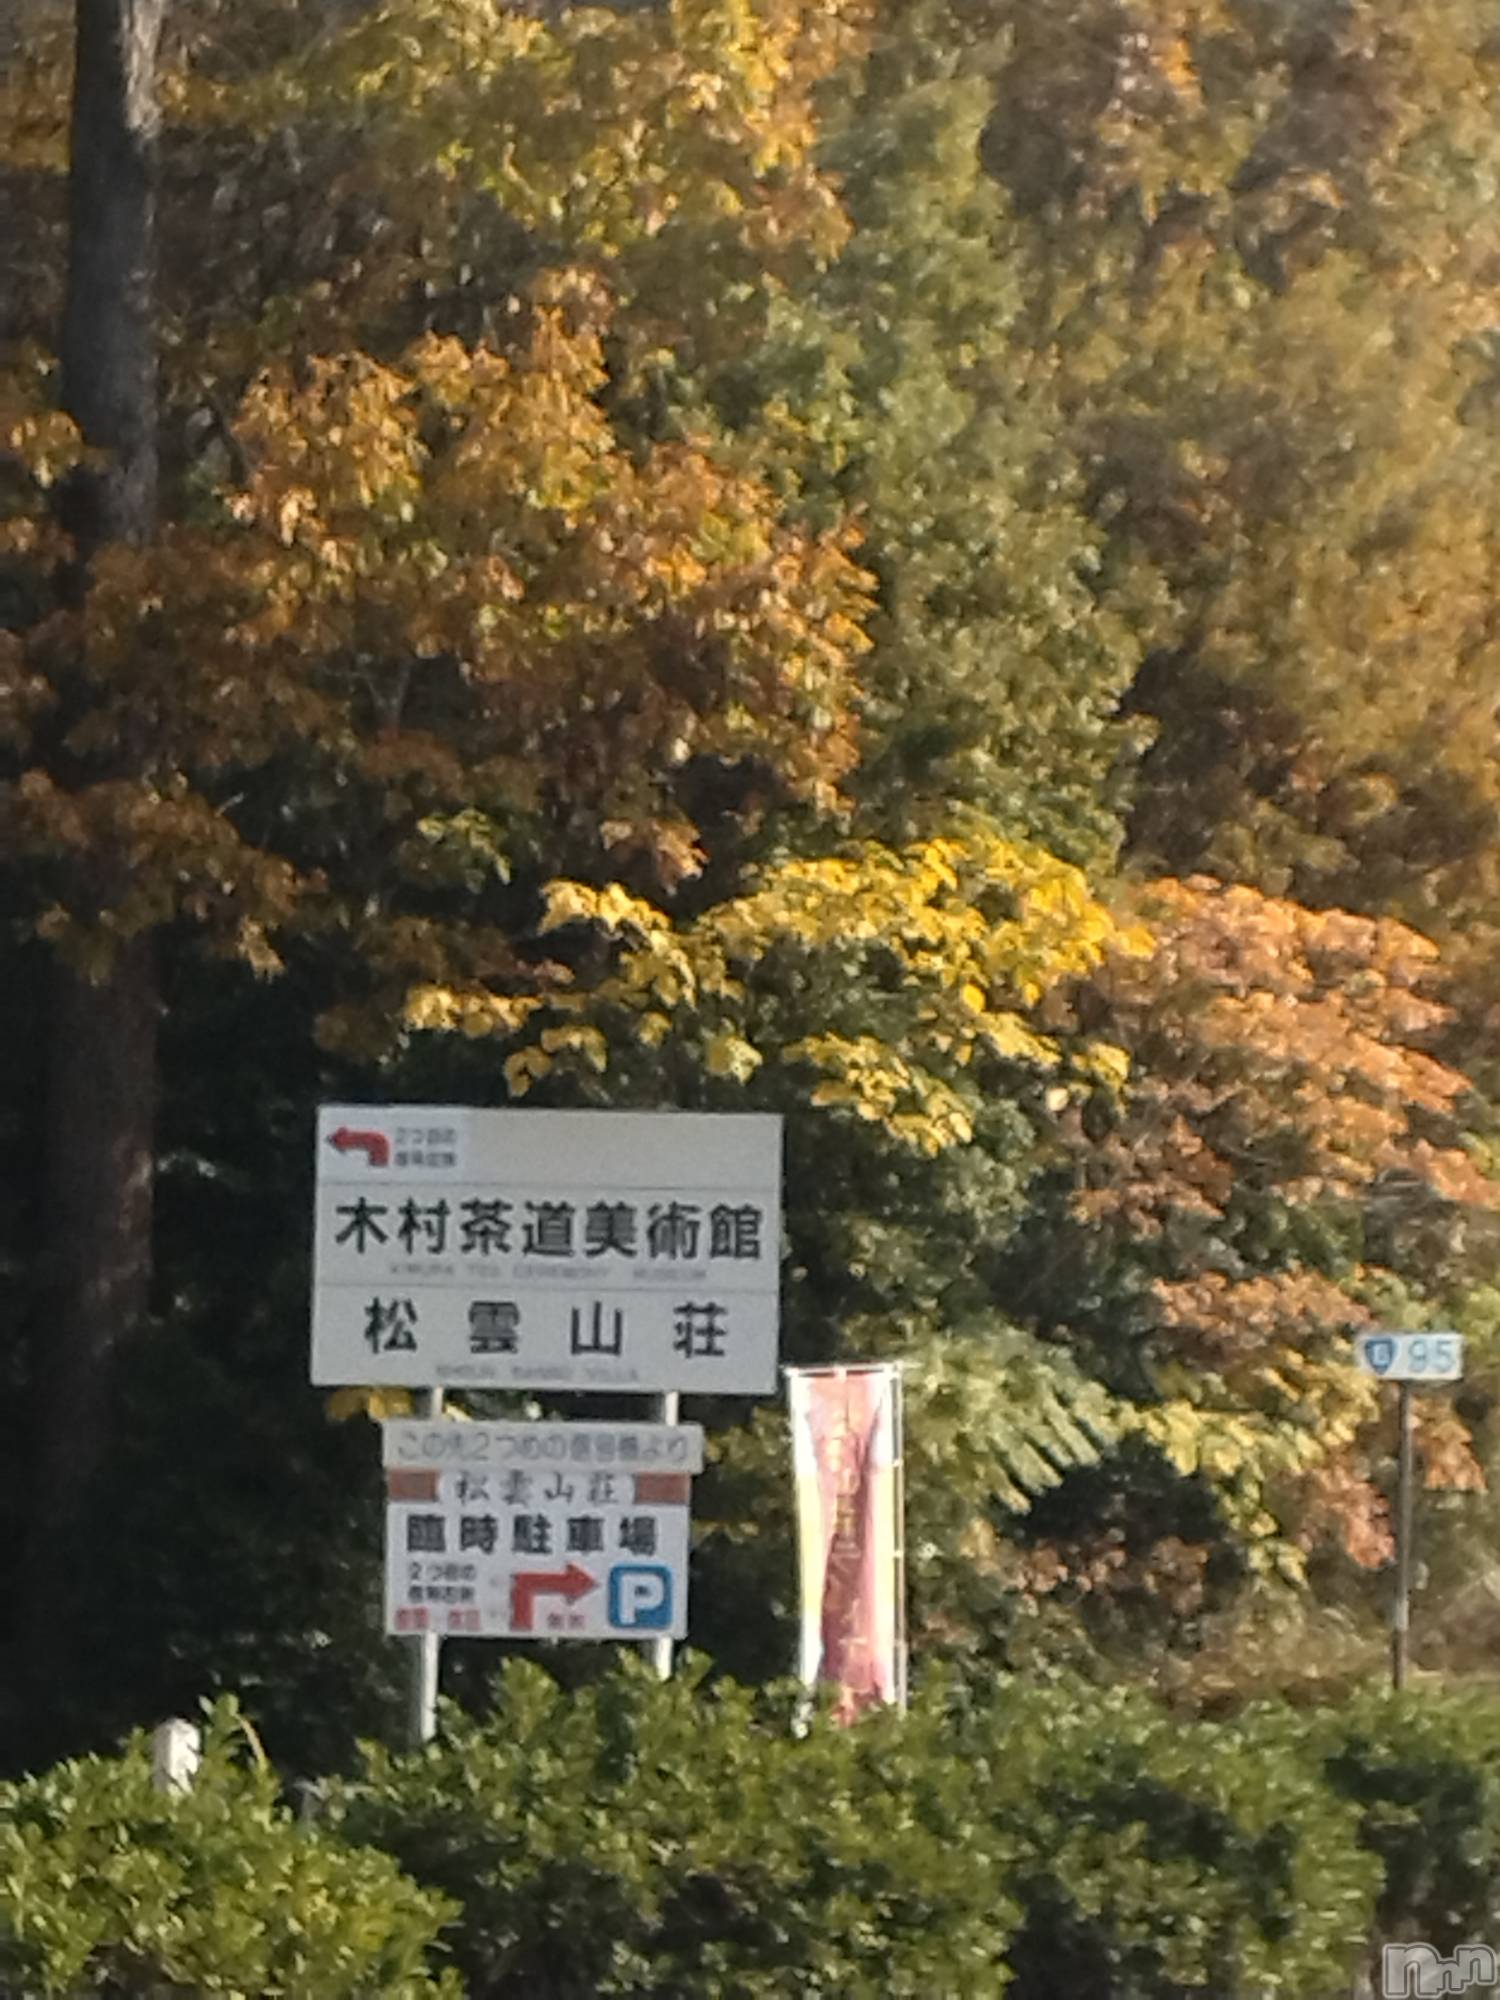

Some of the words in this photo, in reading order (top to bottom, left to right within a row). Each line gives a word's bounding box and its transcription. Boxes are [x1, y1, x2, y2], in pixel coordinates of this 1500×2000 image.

[335, 1196, 764, 1261] 木村茶道美術館
[364, 1297, 728, 1359] 松雲山荘
[407, 1514, 657, 1556] 臨時駐車場
[618, 1573, 665, 1625] P
